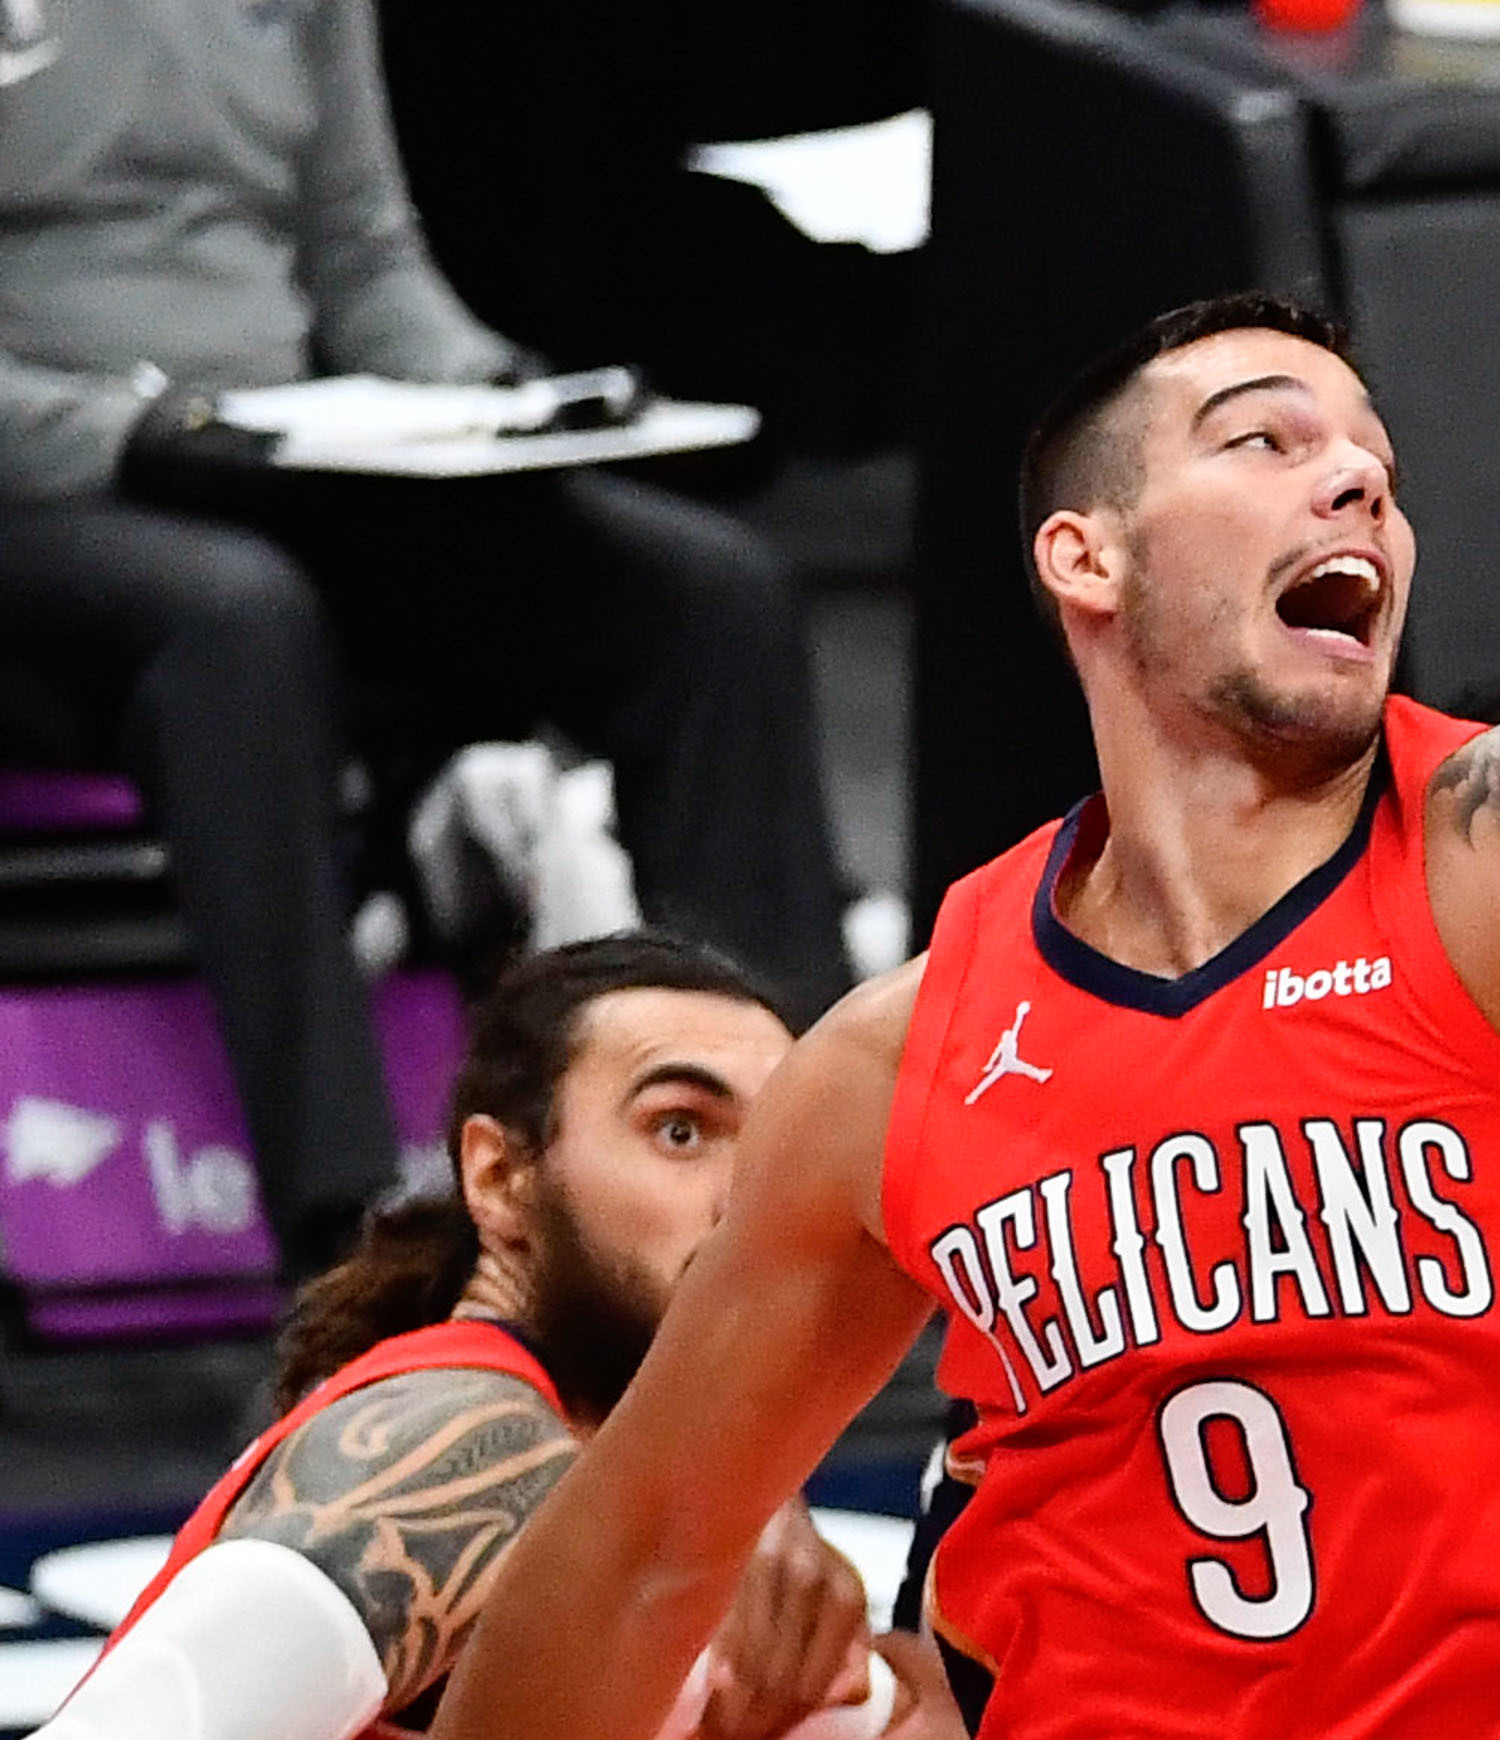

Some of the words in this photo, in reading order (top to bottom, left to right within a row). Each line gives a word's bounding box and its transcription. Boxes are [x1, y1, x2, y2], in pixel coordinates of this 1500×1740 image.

[1262, 956, 1393, 1010] ibotta
[931, 1118, 1494, 1413] PELICANS
[1158, 1377, 1314, 1641] 9
